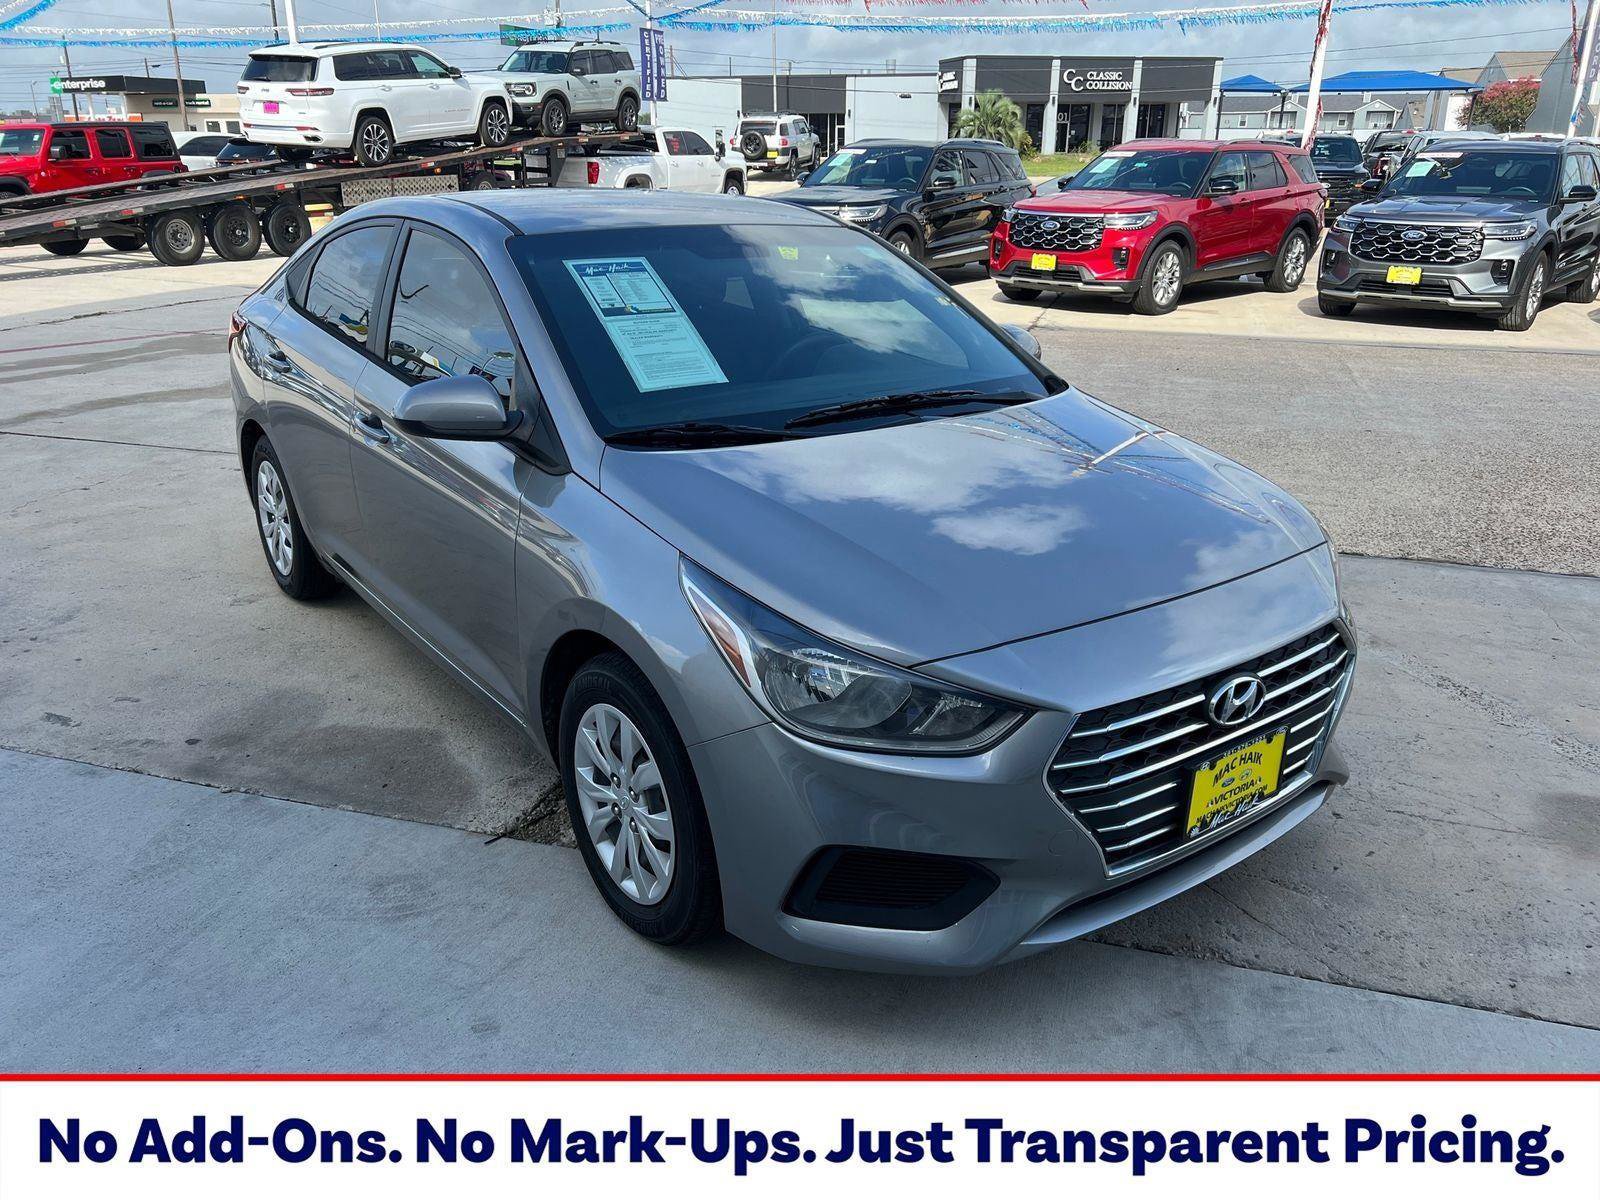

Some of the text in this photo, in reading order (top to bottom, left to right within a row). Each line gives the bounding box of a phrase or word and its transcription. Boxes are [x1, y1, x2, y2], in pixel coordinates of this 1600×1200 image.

[643, 32, 652, 98] CERTIFIED
[52, 78, 105, 91] enterprise
[1086, 71, 1122, 81] CLASSIC
[1086, 80, 1132, 90] COLLISION
[1212, 756, 1237, 787] MAC
[1238, 751, 1263, 765] HAIK
[1214, 779, 1256, 805] VICTORIA
